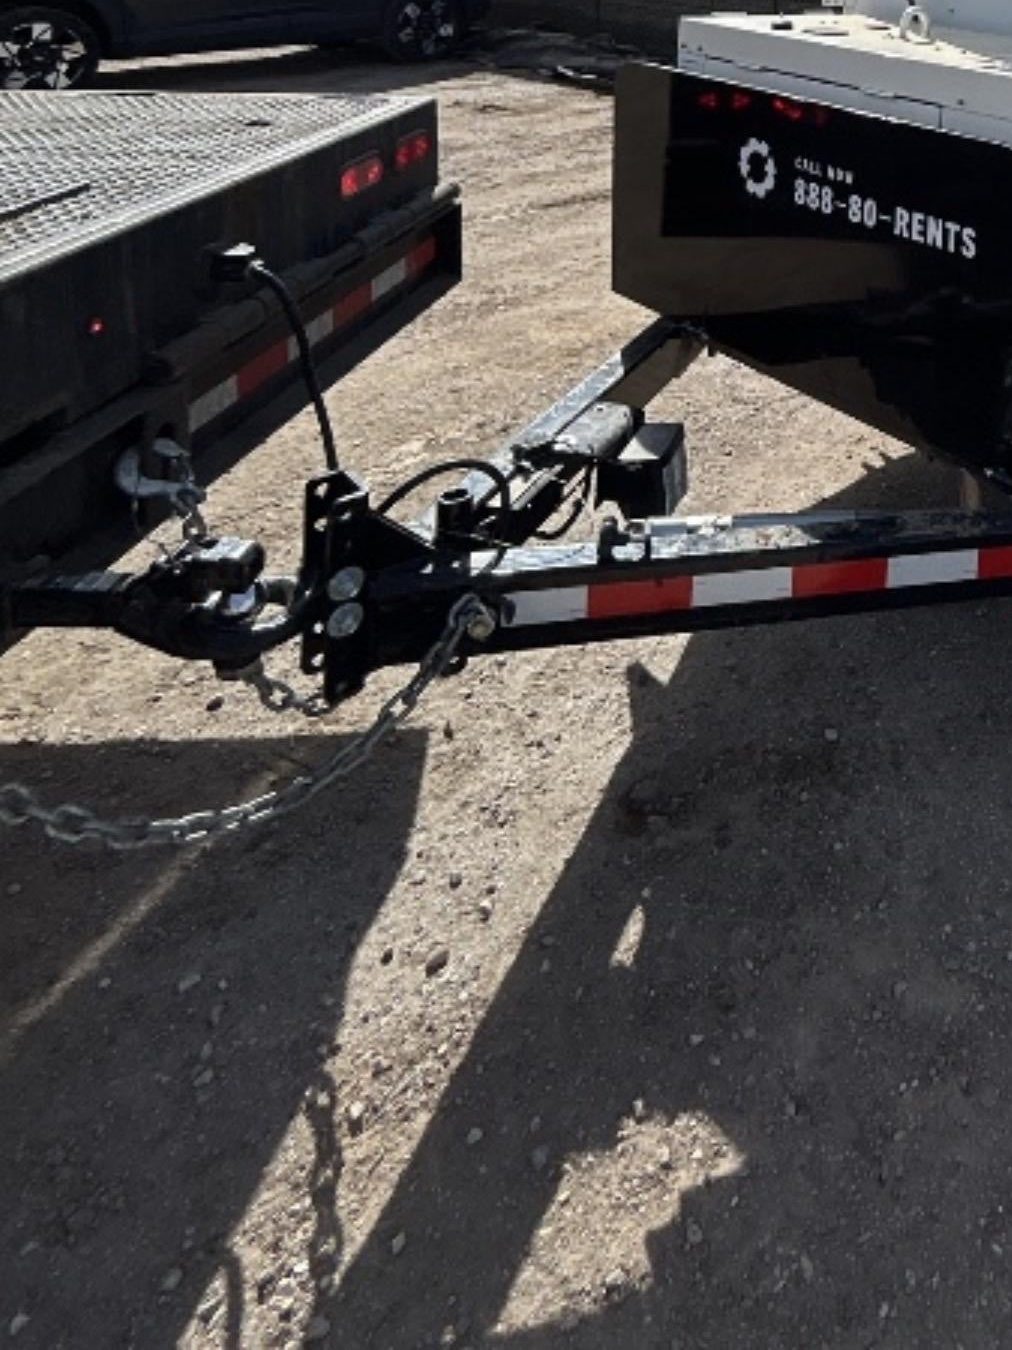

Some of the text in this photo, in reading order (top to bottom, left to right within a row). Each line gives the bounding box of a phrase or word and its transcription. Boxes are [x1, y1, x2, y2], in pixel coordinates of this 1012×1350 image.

[794, 156, 854, 185] CALL NOW
[793, 176, 978, 260] 888-80-RENTS
